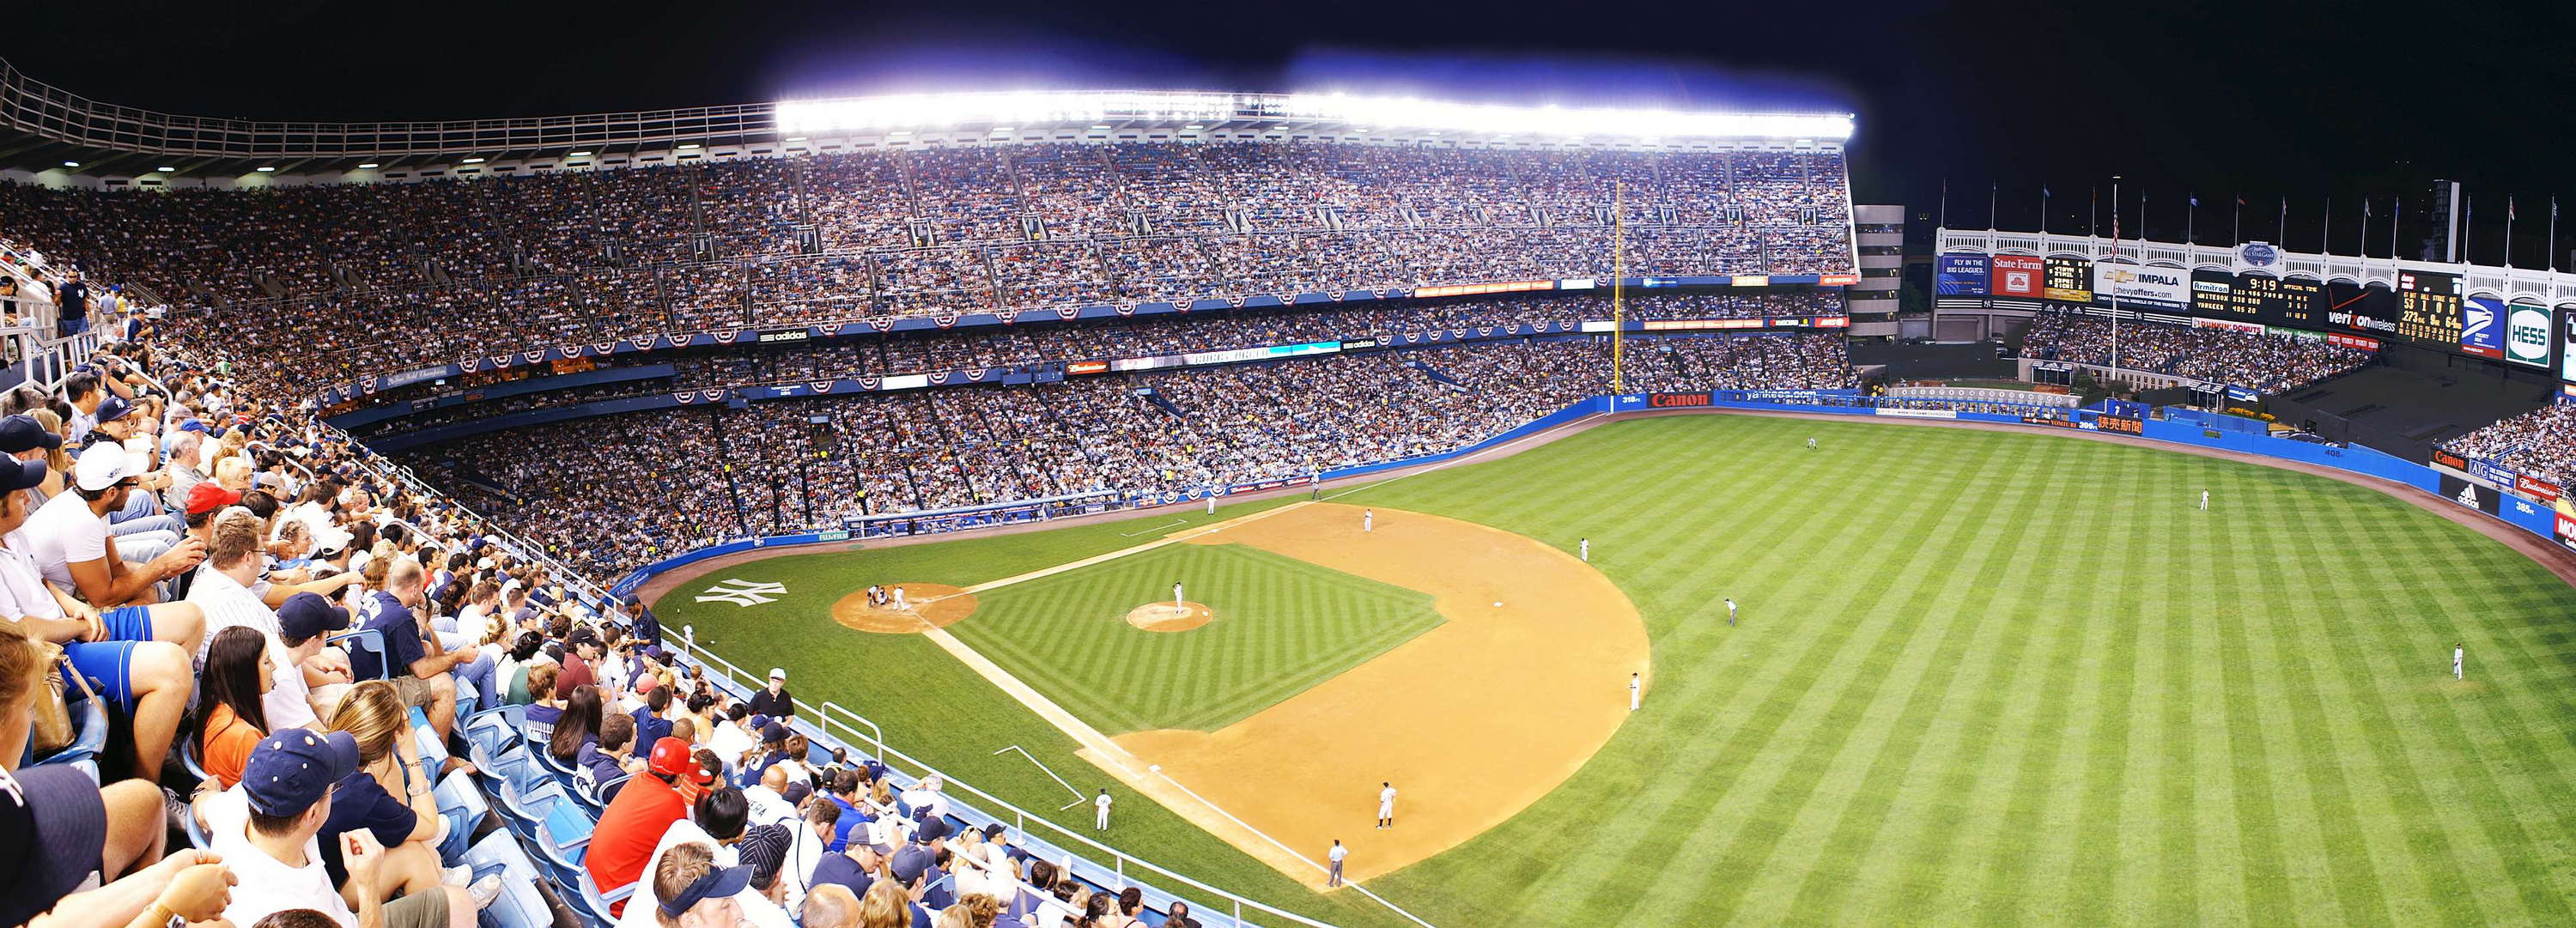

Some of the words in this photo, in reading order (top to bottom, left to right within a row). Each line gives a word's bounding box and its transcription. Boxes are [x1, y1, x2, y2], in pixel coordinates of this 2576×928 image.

[1994, 258, 2016, 269] State
[2018, 259, 2042, 270] Farm
[2138, 273, 2179, 287] IMPALA
[2250, 278, 2276, 291] 9:19
[2194, 282, 2228, 293] Armitron
[2197, 301, 2224, 311] YANKEES
[2403, 298, 2415, 310] 53
[2421, 300, 2427, 312] 1
[2436, 302, 2442, 313] 0
[2449, 303, 2456, 315] 0
[2200, 320, 2232, 331] DUNKIN'
[2233, 324, 2262, 334] DONUTS
[775, 331, 807, 341] adidas
[2512, 324, 2546, 346] HESS
[1651, 393, 1709, 407] Canon
[1746, 390, 1817, 401] yankees.com
[2050, 420, 2077, 428] YOMIURI
[2098, 415, 2142, 434] 読売新聞
[2434, 450, 2464, 470] Canon
[2471, 463, 2488, 477] AIG
[2519, 476, 2557, 497] Budweiser
[2458, 495, 2480, 510] adidas
[819, 531, 849, 541] FUJIFILM
[2558, 517, 2576, 541] MO
